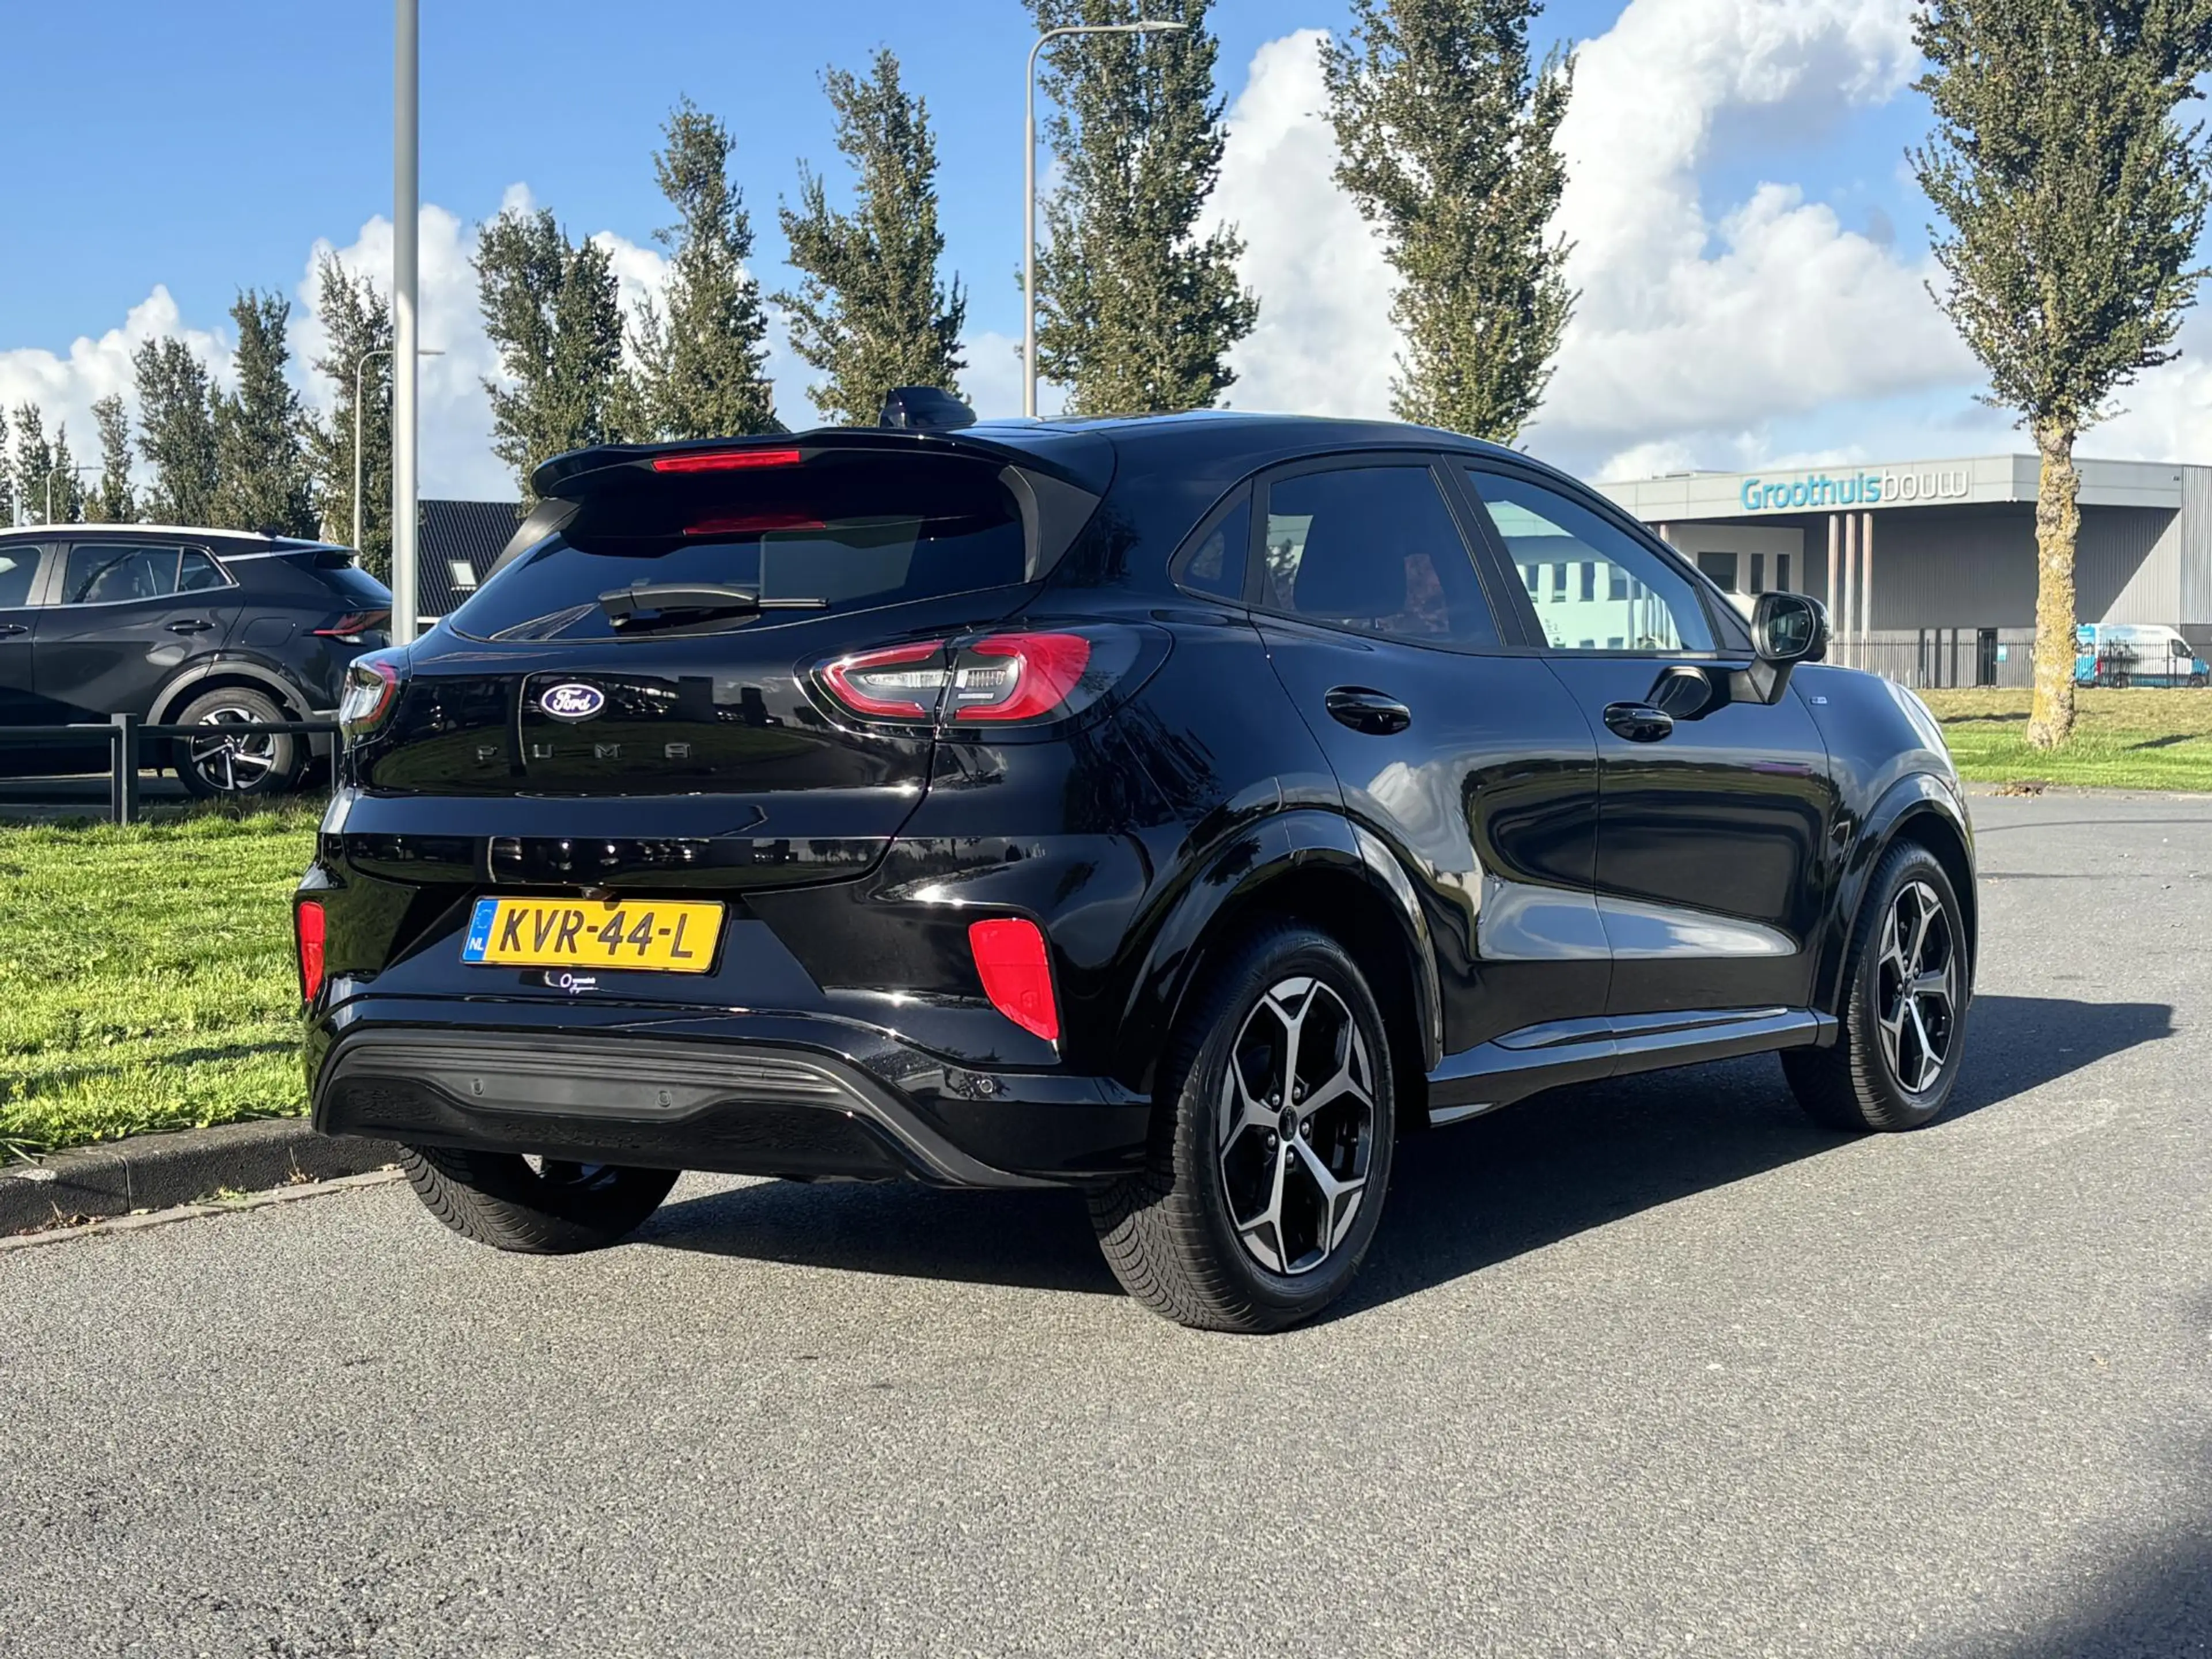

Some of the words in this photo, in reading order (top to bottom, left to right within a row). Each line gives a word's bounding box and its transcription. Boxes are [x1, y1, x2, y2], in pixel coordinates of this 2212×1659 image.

[1741, 468, 1969, 510] Groothuisbouw
[552, 689, 591, 711] Ford
[477, 744, 691, 761] PUMA
[468, 937, 484, 951] NL
[499, 908, 693, 958] KVR-44-L
